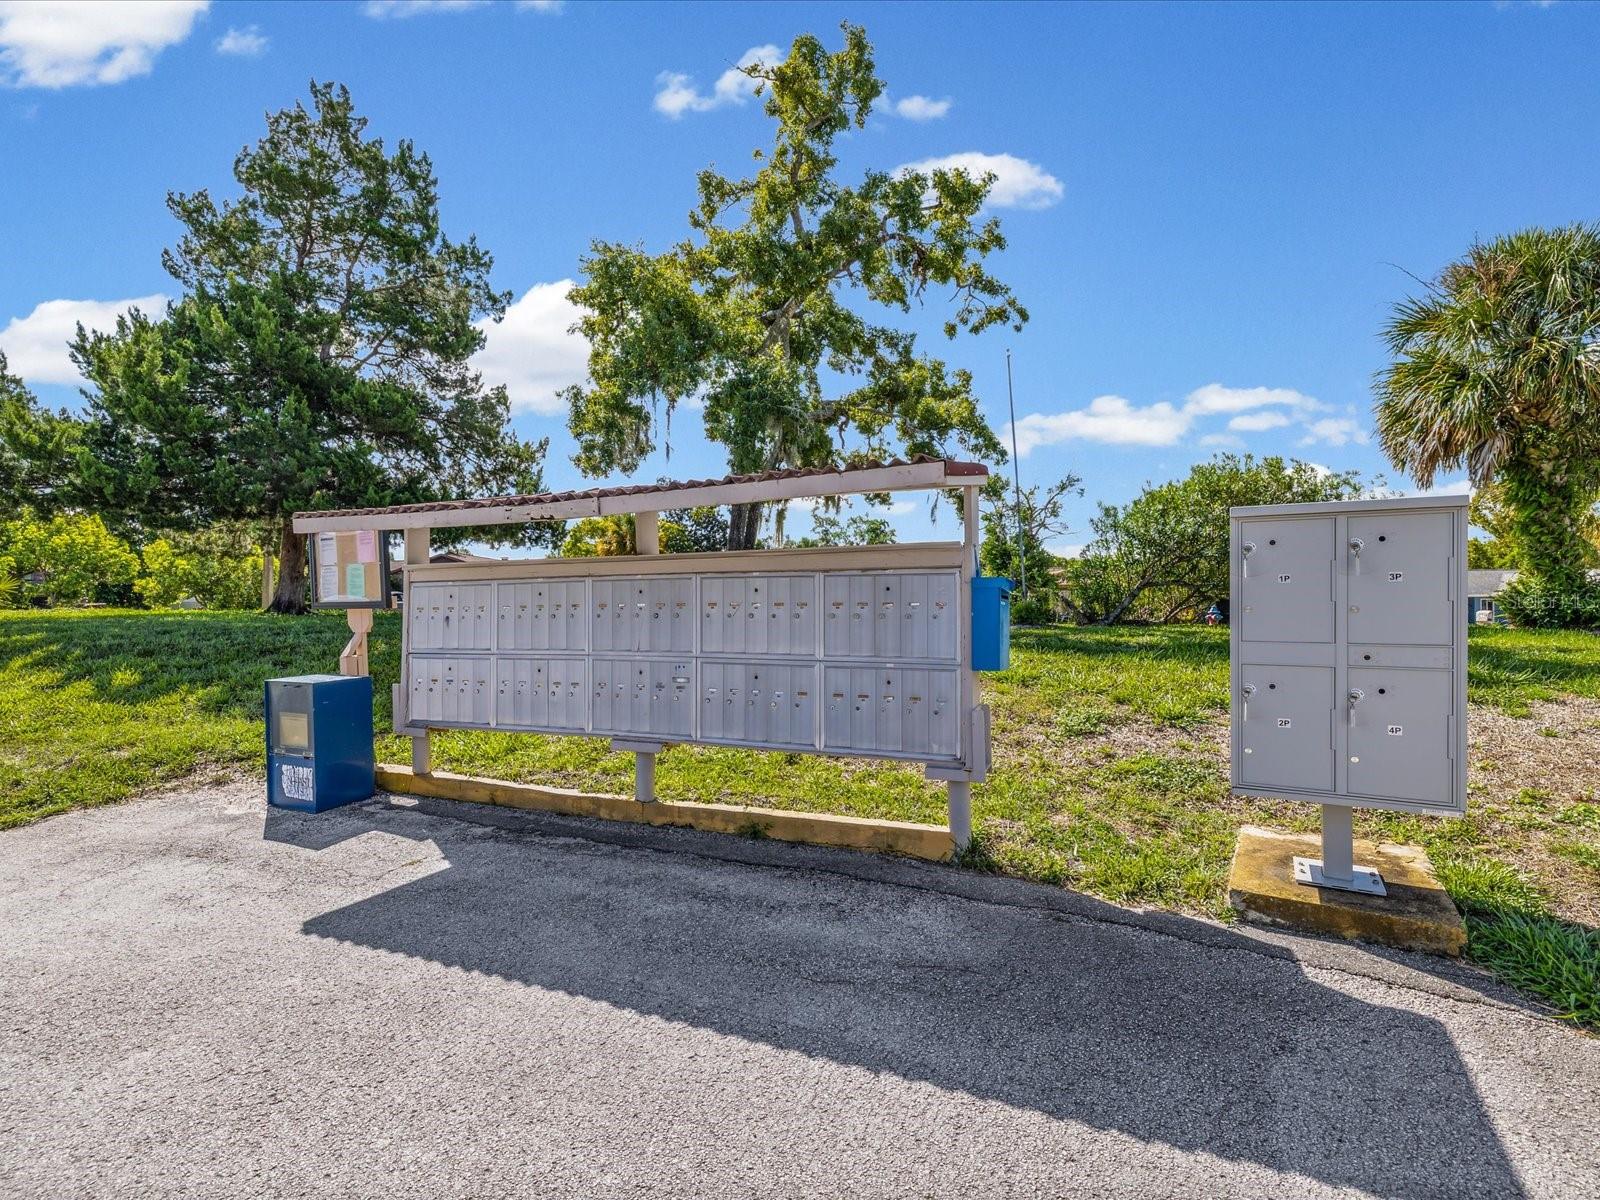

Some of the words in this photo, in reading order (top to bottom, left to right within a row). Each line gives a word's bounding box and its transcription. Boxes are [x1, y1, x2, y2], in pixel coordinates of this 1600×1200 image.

[1279, 575, 1291, 583] 1P
[1389, 573, 1402, 582] 3P
[1279, 719, 1290, 727] 2P
[1389, 727, 1402, 735] 4P
